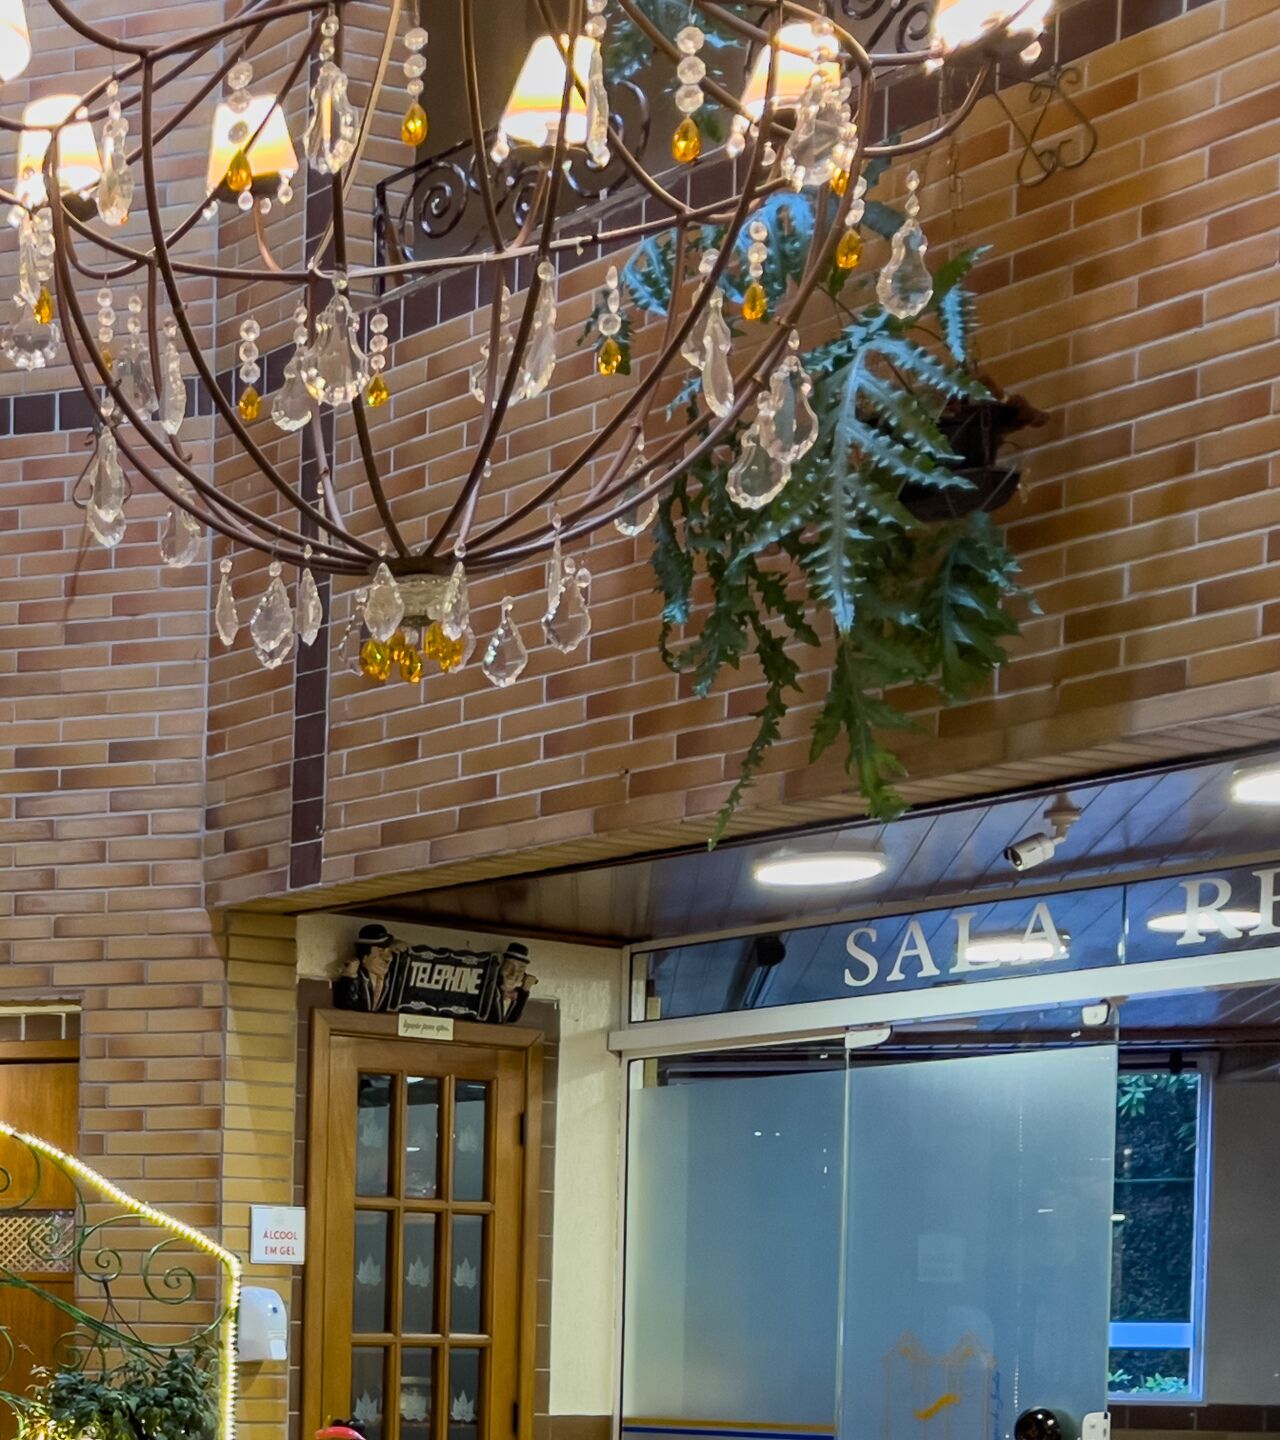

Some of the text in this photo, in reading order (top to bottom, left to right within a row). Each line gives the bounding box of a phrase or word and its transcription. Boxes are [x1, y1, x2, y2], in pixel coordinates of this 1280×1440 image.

[843, 901, 1070, 988] SALA
[409, 960, 484, 995] TELEPHONE
[265, 1246, 296, 1256] EM GEL
